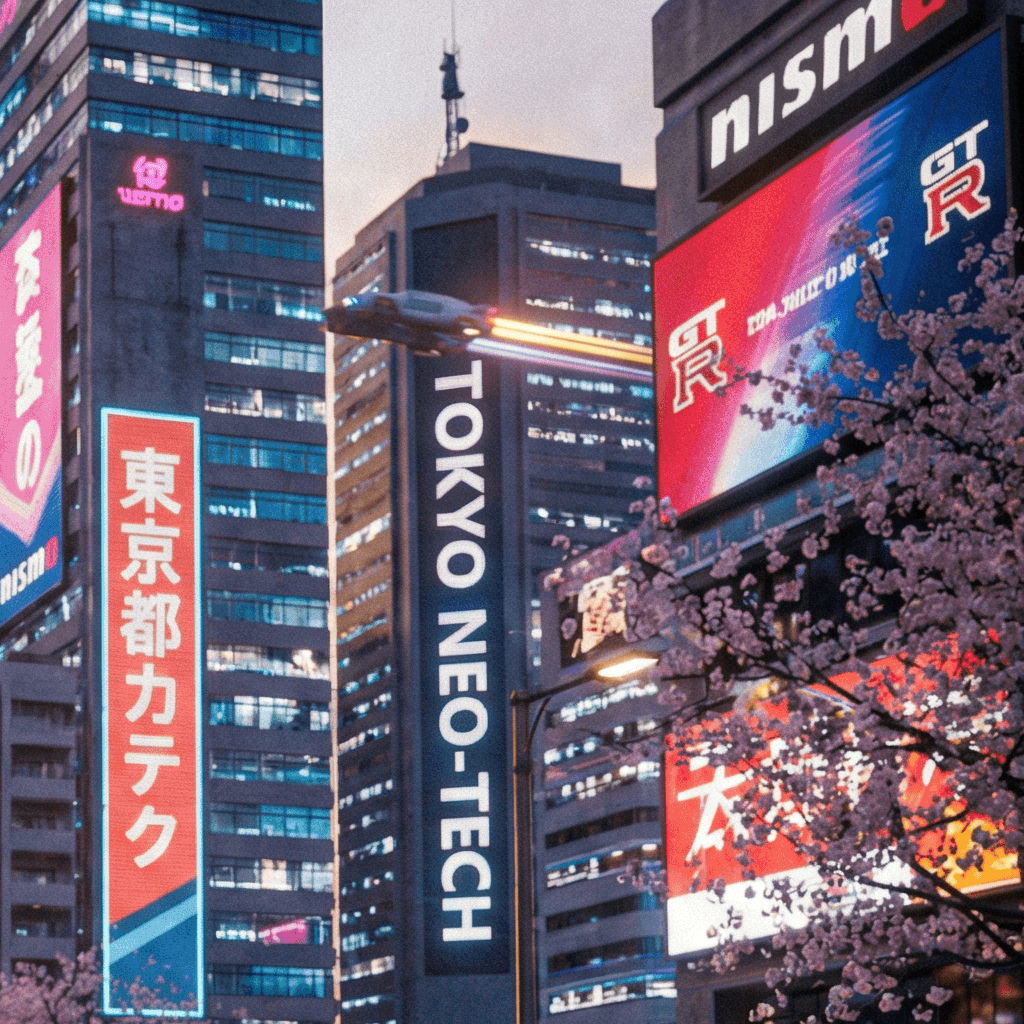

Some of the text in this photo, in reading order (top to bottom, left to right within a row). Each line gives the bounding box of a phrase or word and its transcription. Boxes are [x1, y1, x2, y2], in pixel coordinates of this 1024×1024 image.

[0, 535, 58, 604] nismo
[434, 360, 492, 942] TOKYO NEO-TECH
